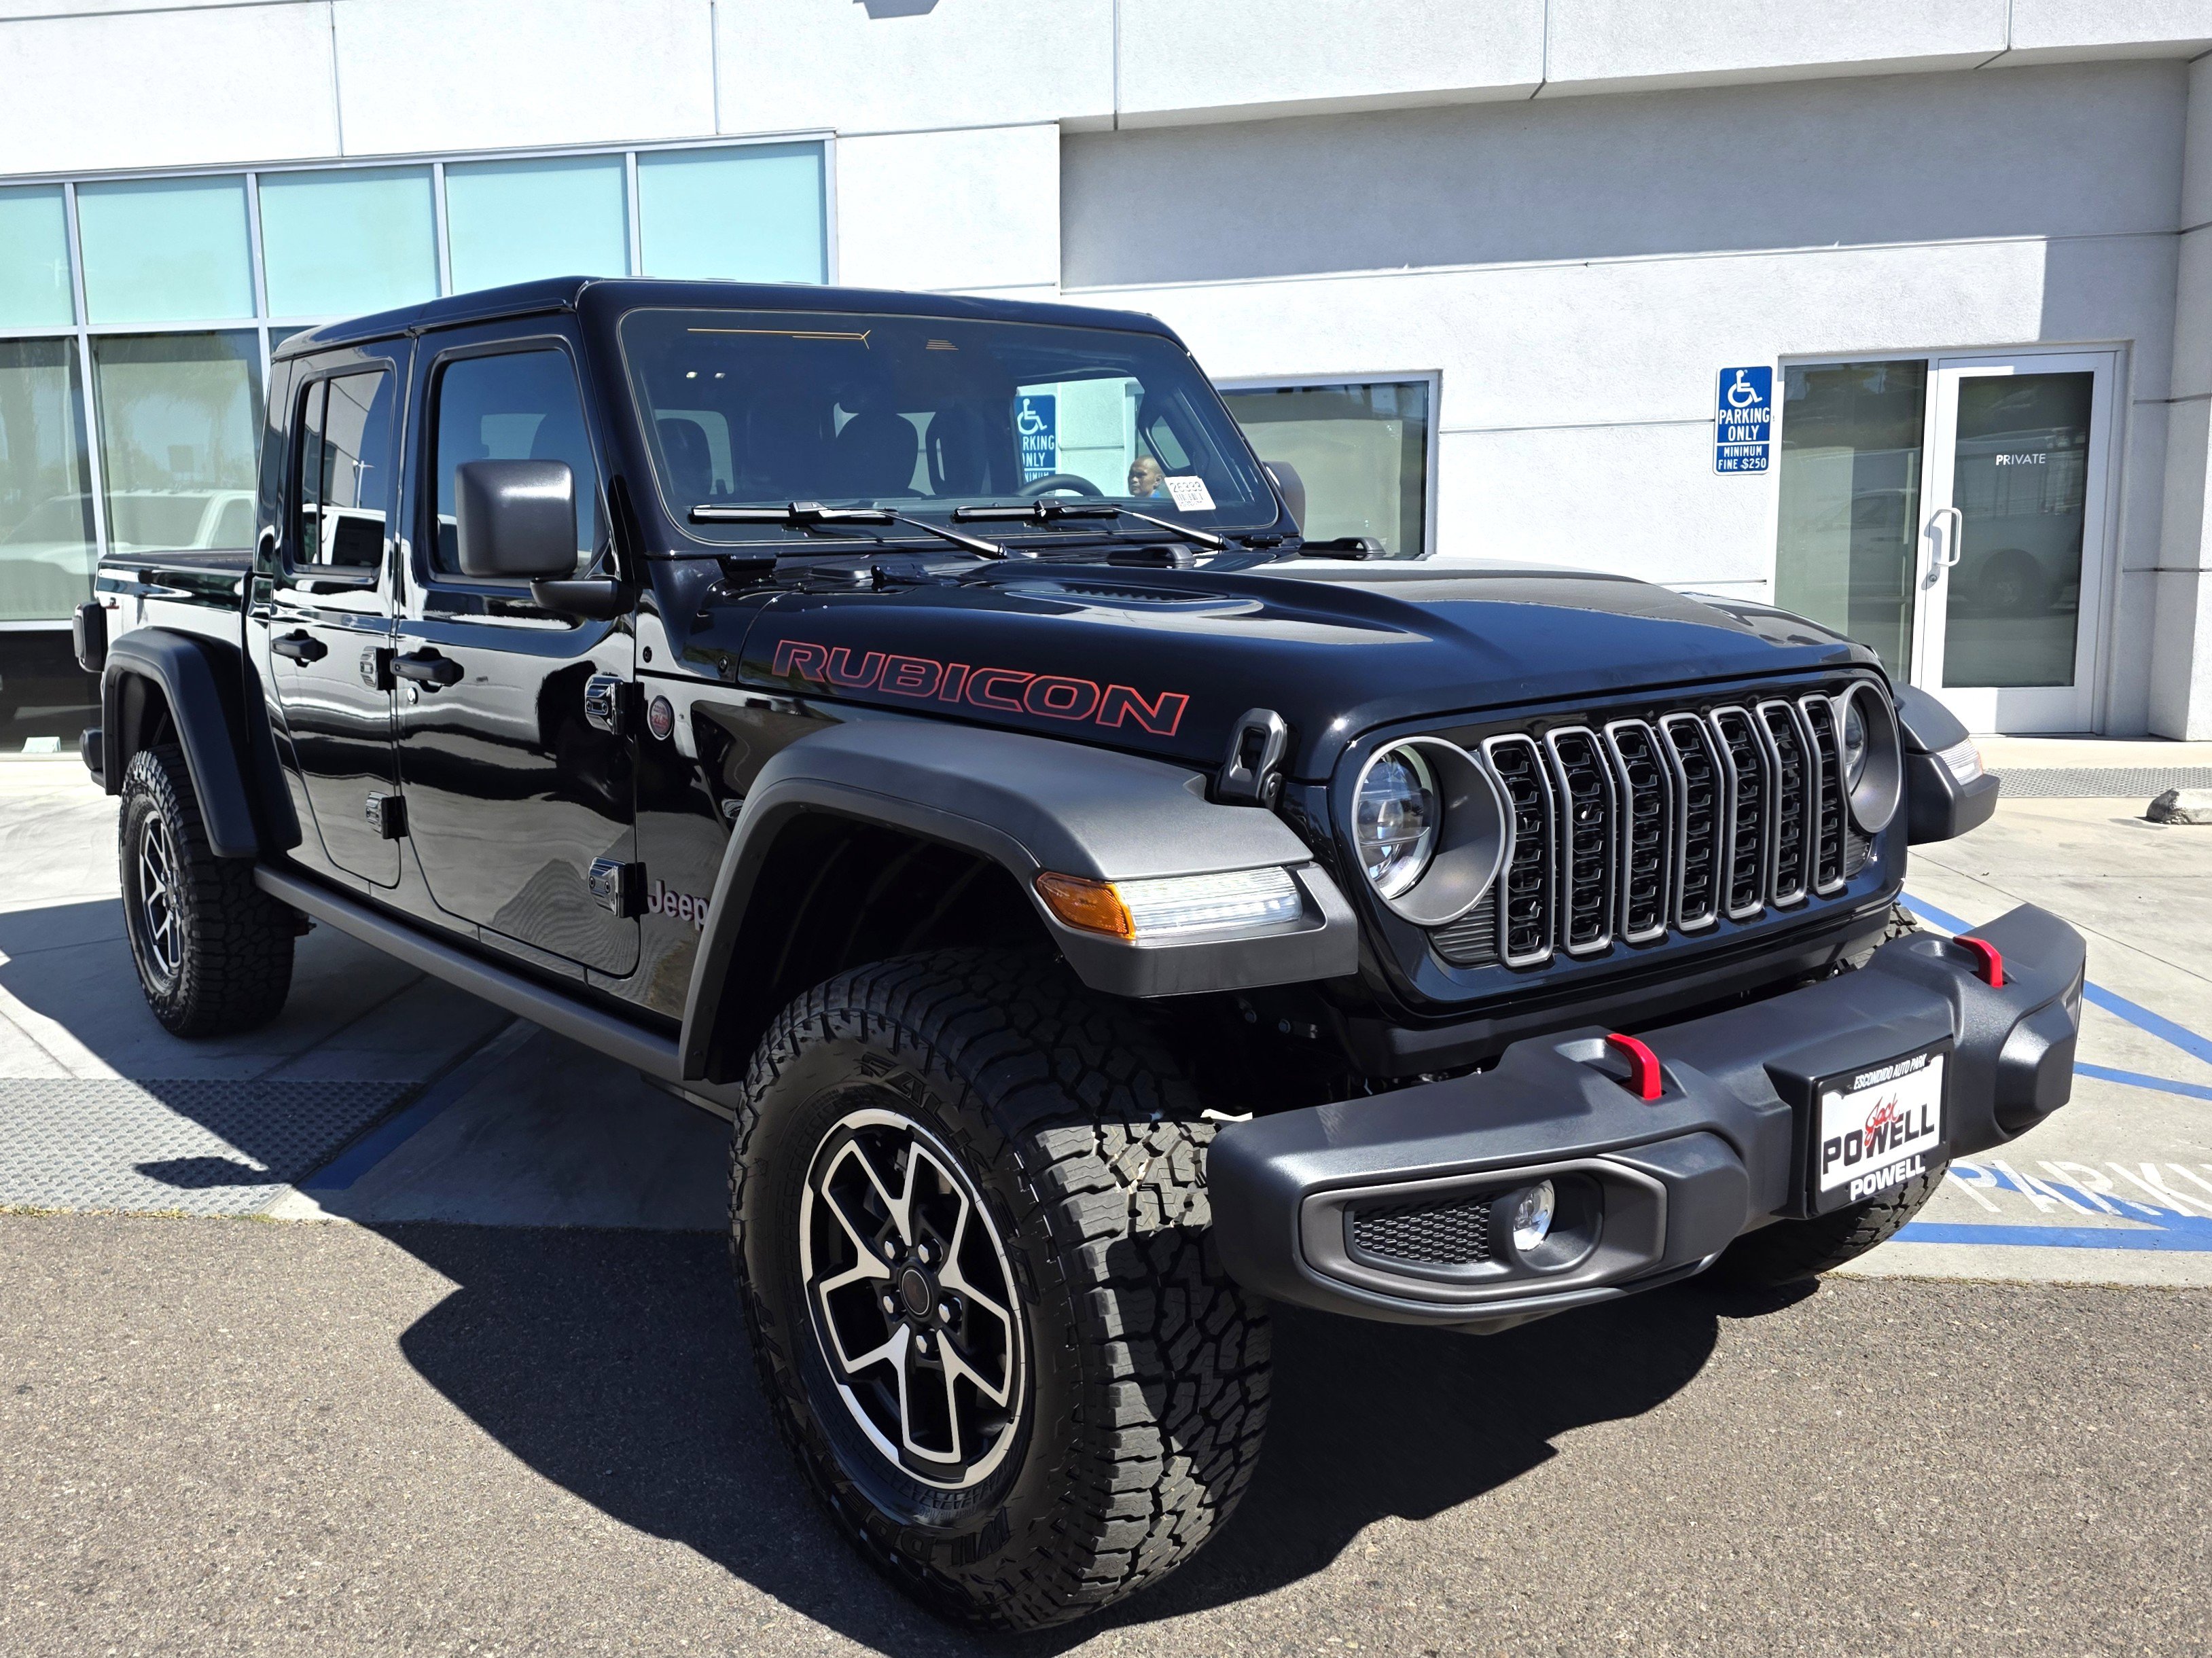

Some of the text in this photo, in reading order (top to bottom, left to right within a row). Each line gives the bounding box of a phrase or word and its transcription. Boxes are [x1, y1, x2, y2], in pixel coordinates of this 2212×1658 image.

[1719, 407, 1770, 425] PARKING
[1022, 435, 1055, 450] RKING
[1728, 425, 1760, 441] ONLY
[1718, 457, 1767, 470] FINE $250
[1724, 446, 1762, 458] MINIMUM
[1995, 453, 2046, 466] PRIVATE
[771, 639, 1190, 737] RUBICON
[647, 878, 710, 932] Jeep
[1853, 1053, 1928, 1090] ESCONDIDO AUTO PARK
[1864, 1092, 1901, 1147] Jack
[1823, 1103, 1935, 1176] POWELL
[1850, 1154, 1926, 1202] POWELL
